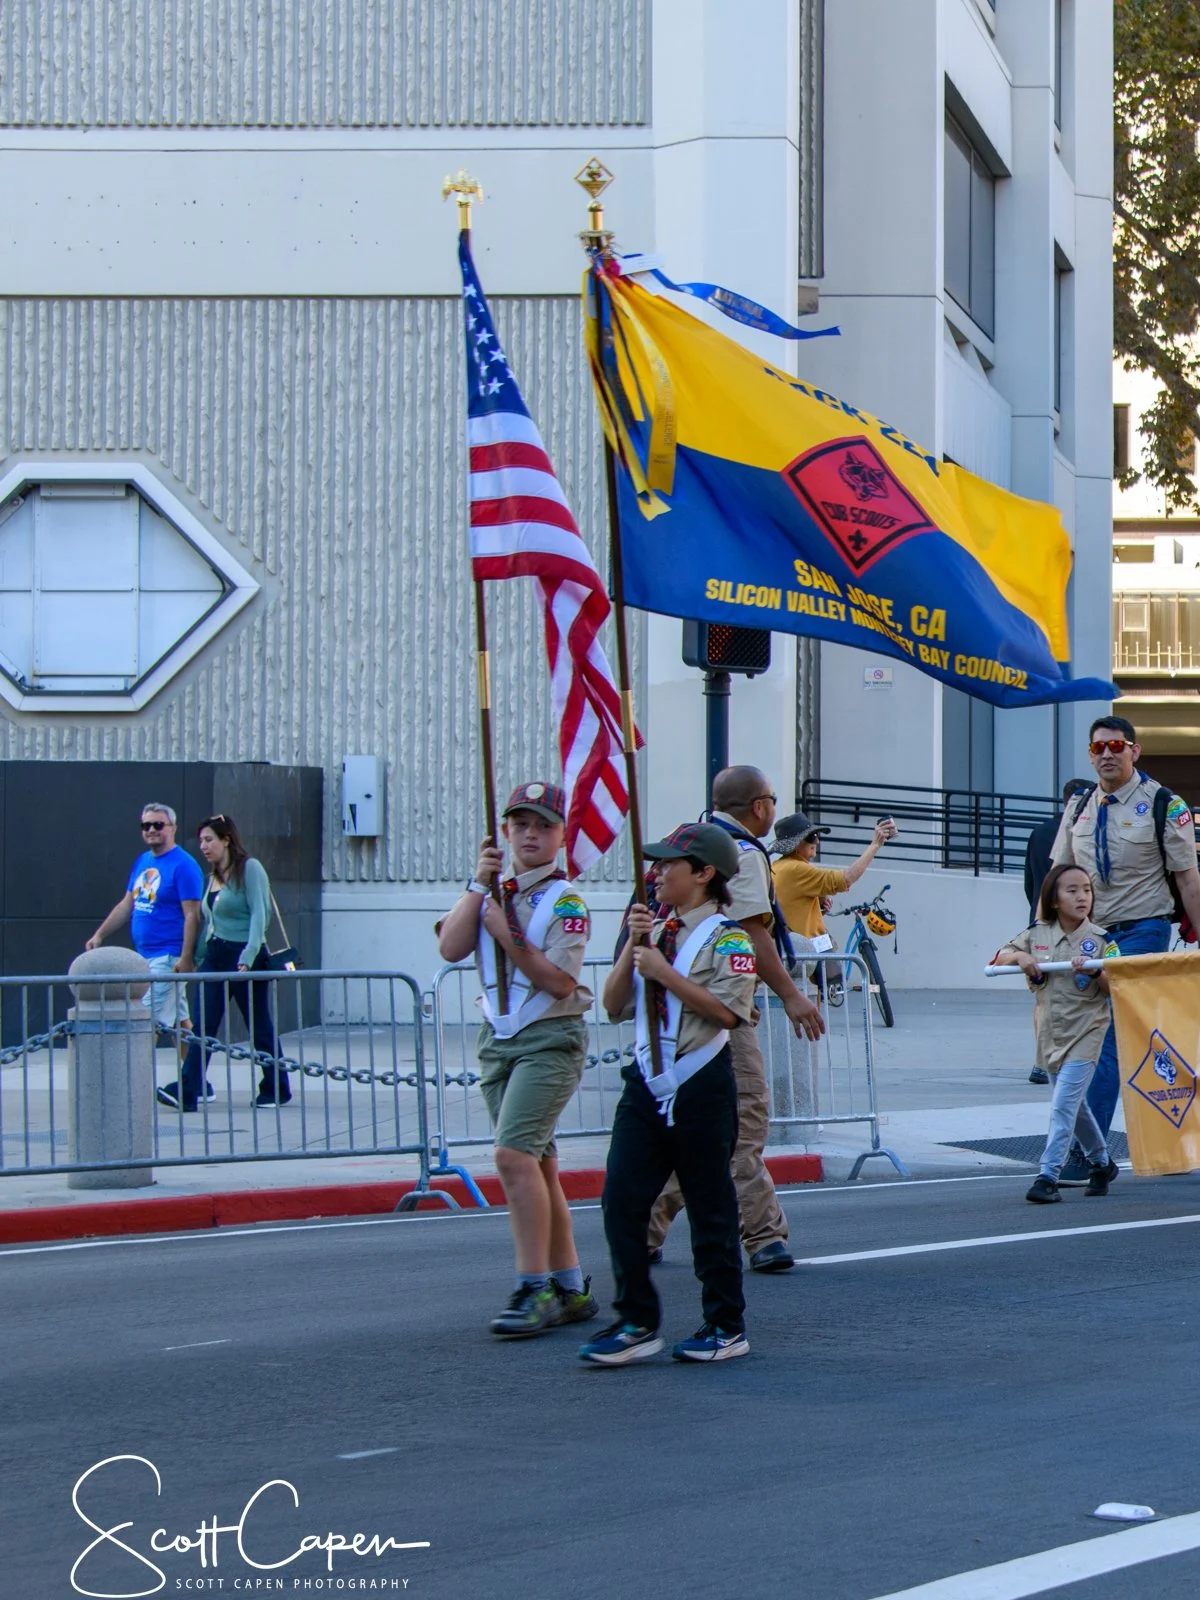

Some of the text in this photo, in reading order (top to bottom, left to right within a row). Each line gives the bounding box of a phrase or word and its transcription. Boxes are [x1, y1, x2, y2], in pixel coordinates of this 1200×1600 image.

[706, 578, 782, 610] SILICON
[787, 590, 846, 622] VALLEY
[918, 643, 950, 671] BAY
[955, 654, 1028, 690] COUNCIL
[794, 559, 946, 642] SAN JOSE, CA
[733, 956, 754, 971] 224
